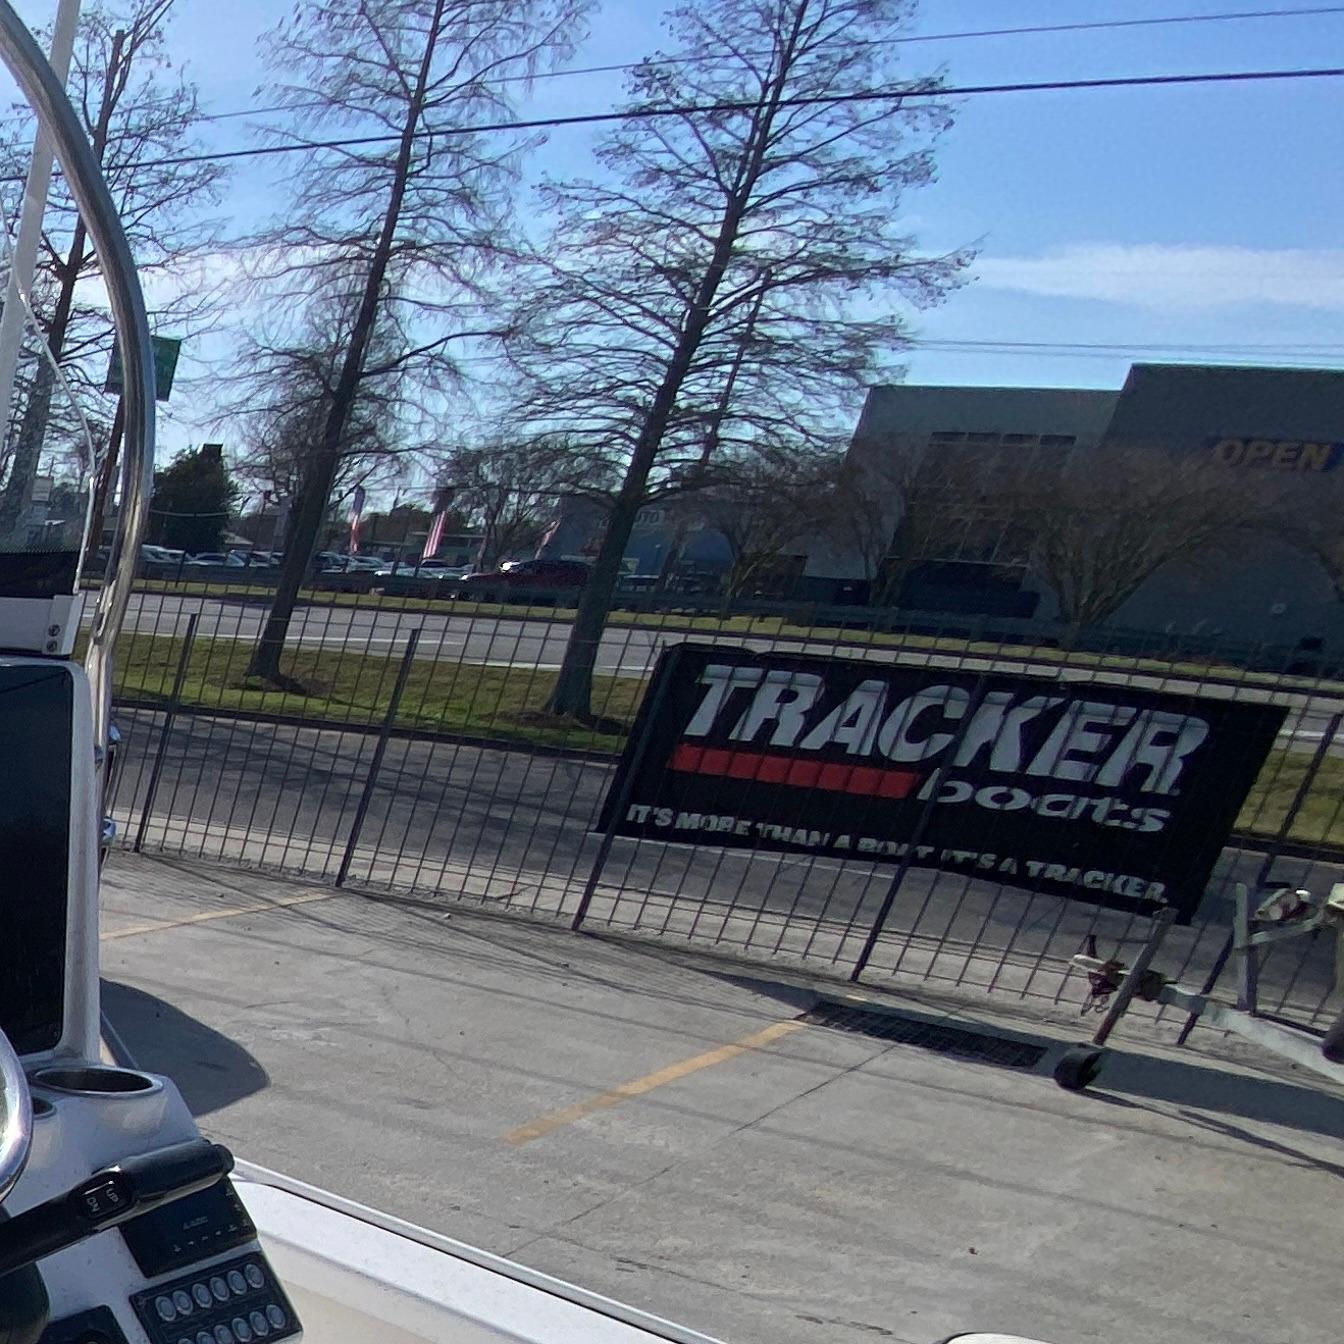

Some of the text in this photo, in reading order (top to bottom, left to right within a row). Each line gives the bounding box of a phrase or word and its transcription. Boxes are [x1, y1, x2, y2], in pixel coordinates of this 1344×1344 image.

[1213, 440, 1331, 472] OPEN
[682, 664, 1209, 793] TRACKER
[916, 767, 1170, 832] boats
[675, 810, 750, 835] MORE
[755, 823, 830, 847] THAN
[833, 835, 854, 850] A
[999, 858, 1017, 875] A
